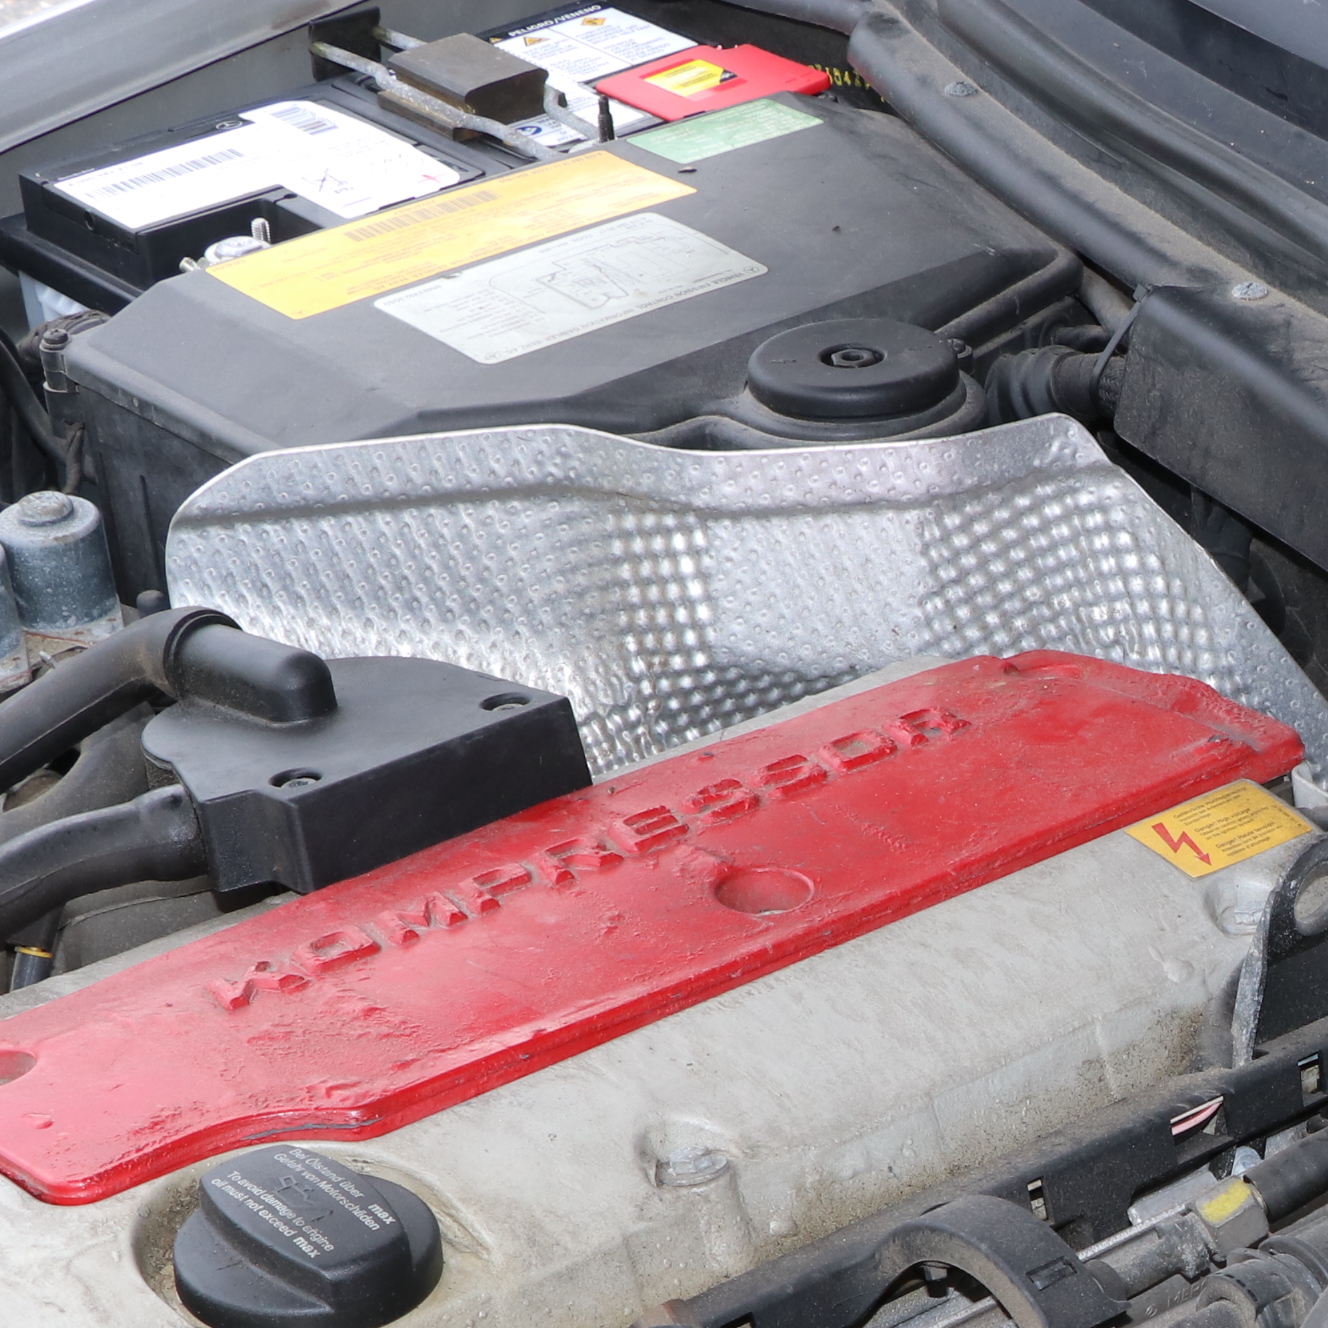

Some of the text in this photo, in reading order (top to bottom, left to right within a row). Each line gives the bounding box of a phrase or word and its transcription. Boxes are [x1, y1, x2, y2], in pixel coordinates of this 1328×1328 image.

[209, 705, 972, 1011] KOMPRESSOR
[1192, 807, 1253, 833] Danger! High voltage
[1212, 820, 1277, 849] Danger! Haute tension
[210, 1177, 322, 1260] oil must not exceed max
[226, 1170, 335, 1253] To avoid damage to engine
[273, 1152, 381, 1232] Gefahr von Motorschäden
[305, 1151, 343, 1184] Ölstand
[338, 1178, 365, 1199] über
[367, 1203, 397, 1226] max
